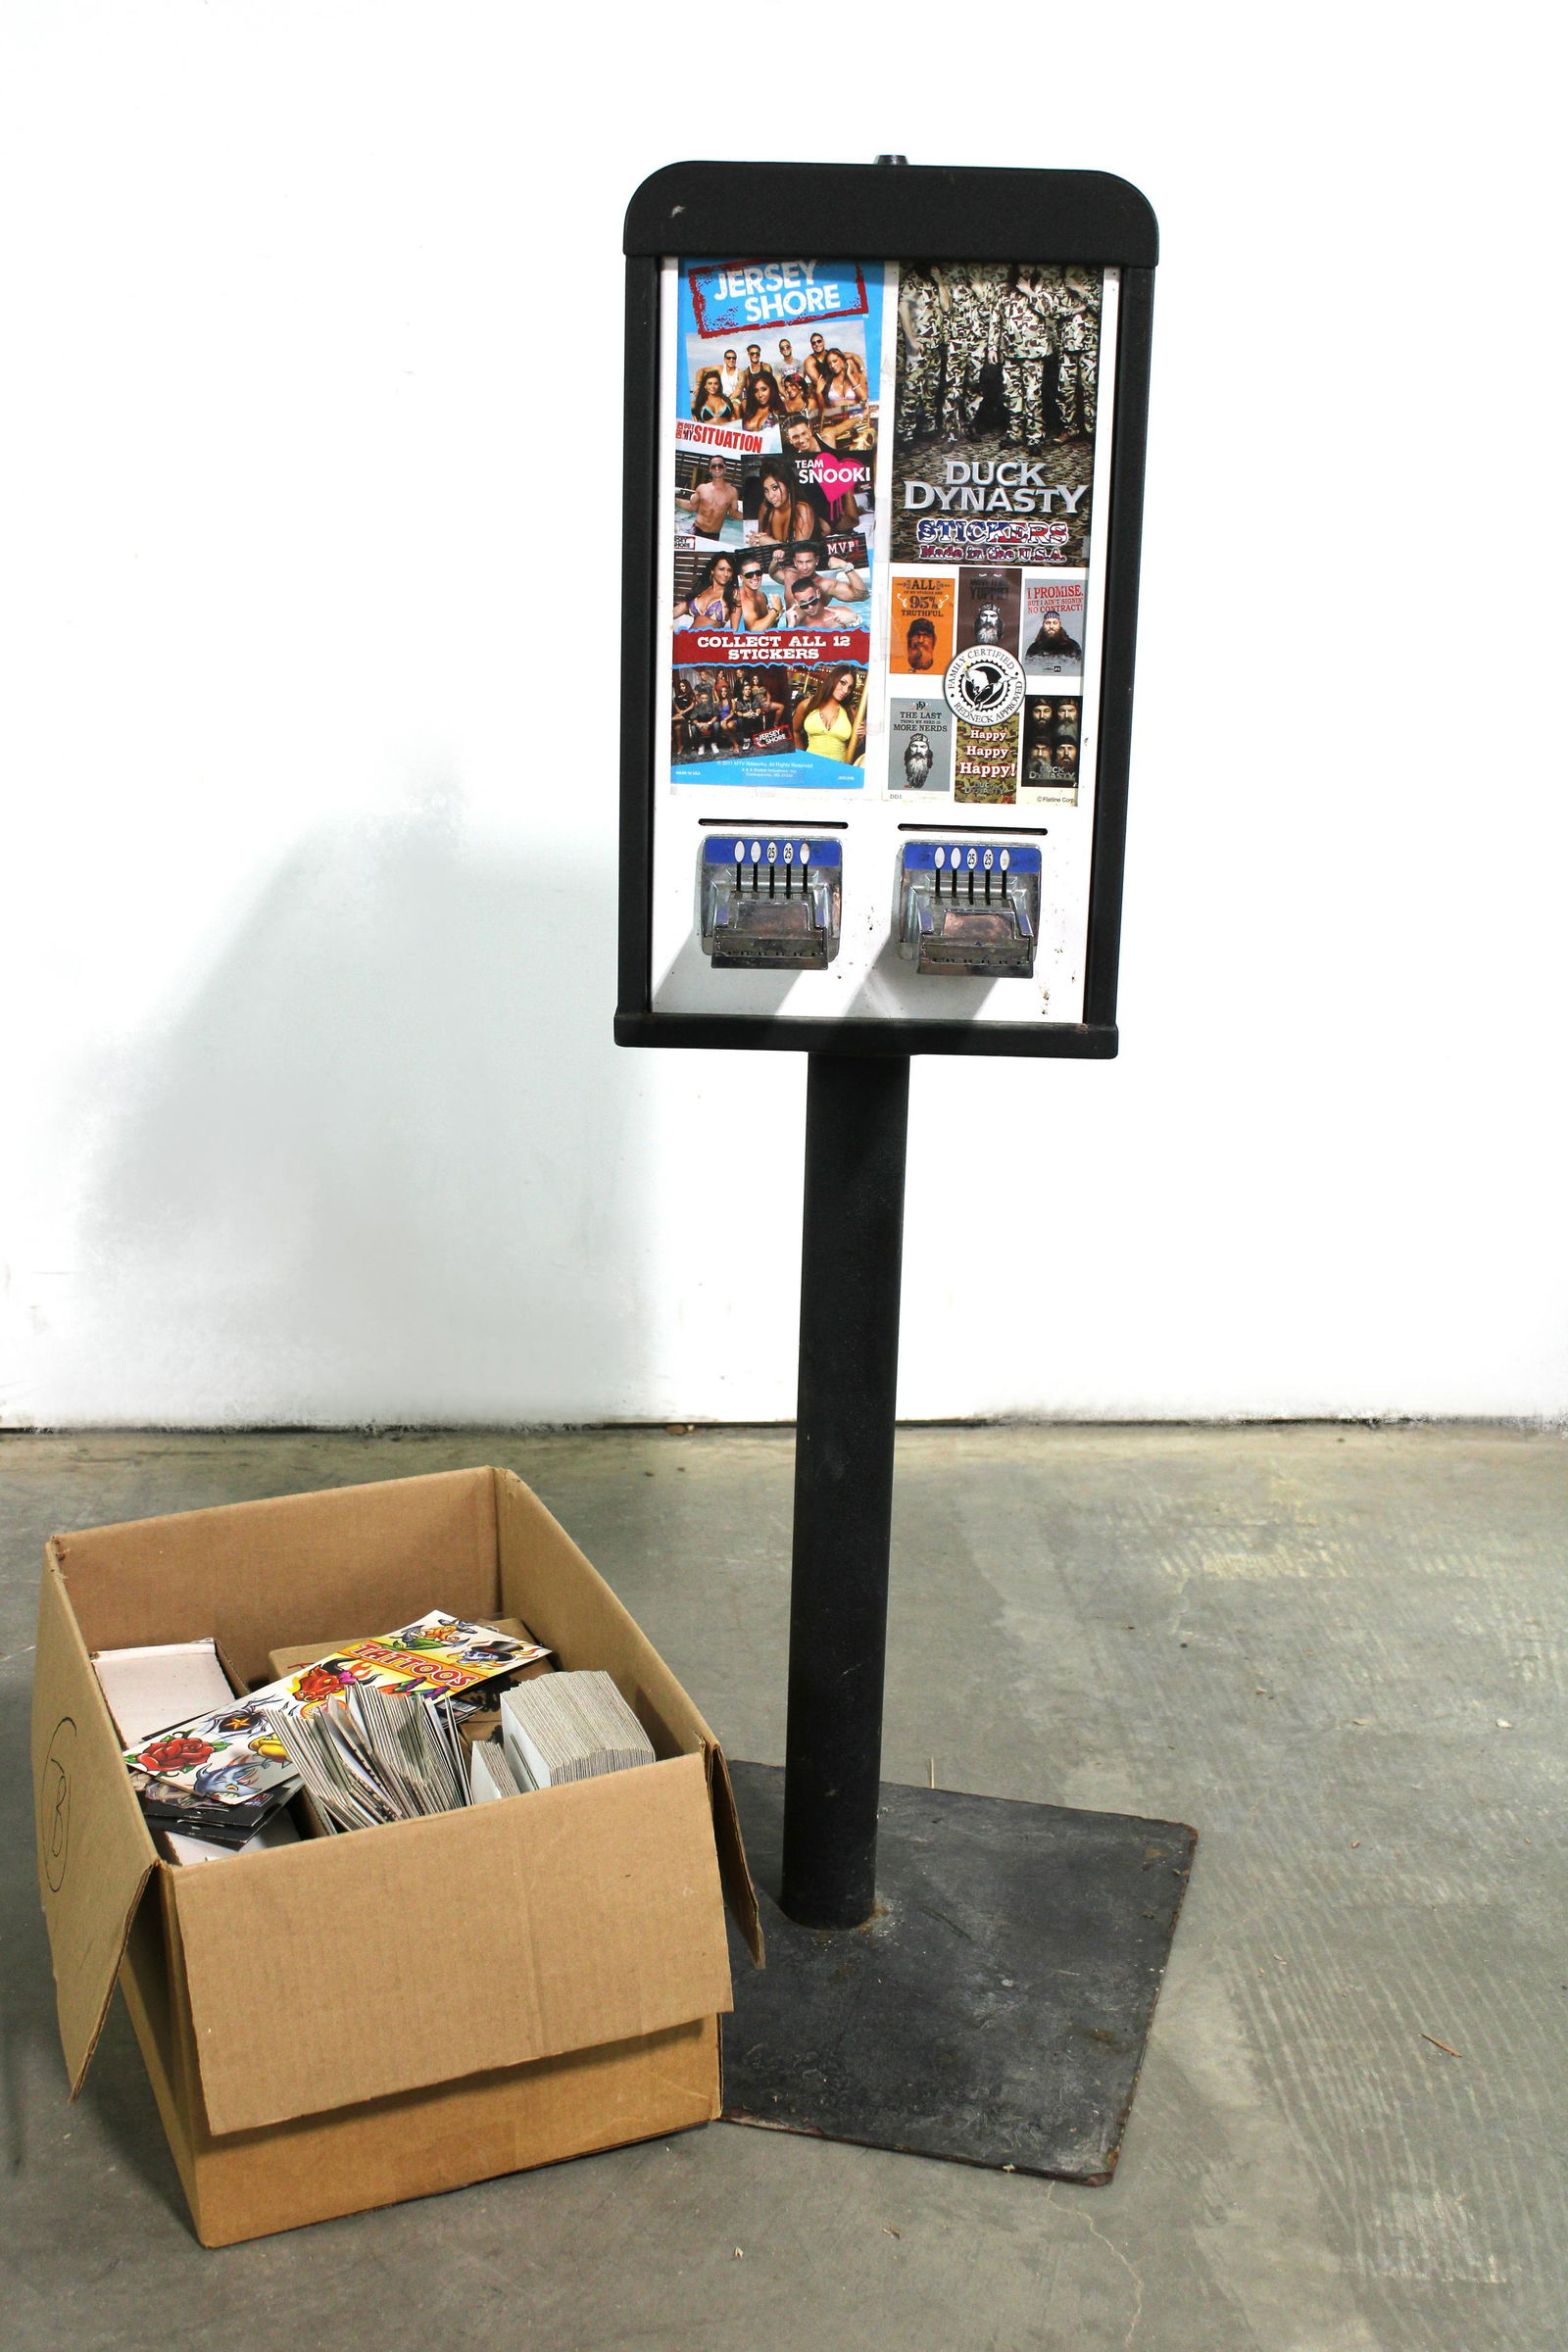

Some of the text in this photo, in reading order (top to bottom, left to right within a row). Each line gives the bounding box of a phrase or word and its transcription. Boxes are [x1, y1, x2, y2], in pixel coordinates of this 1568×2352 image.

[713, 259, 816, 300] JERSEY
[745, 284, 841, 321] SHORE
[693, 424, 762, 453] SITUATION
[795, 460, 824, 469] TEAM
[799, 466, 870, 484] SNOOKI
[945, 461, 1048, 487] DUCK
[903, 480, 1089, 514] DYNASTY
[916, 518, 1068, 544] STICKERS
[919, 545, 1066, 562] Made in the U.S.A.
[911, 580, 936, 590] ALL
[1027, 588, 1031, 599] I
[909, 596, 938, 609] 95%
[697, 636, 851, 649] COLLECT ALL 12
[728, 649, 819, 661] STICKERS
[949, 648, 1014, 689] FAMILY CERTIFIED
[954, 680, 1022, 723] REDNECK APPROVED
[970, 729, 1006, 742] Happy
[966, 746, 1009, 760] Happy
[959, 762, 1016, 778] Happy!
[768, 848, 775, 858] 25
[785, 848, 792, 858] 25
[968, 854, 975, 865] 25
[984, 854, 992, 865] 25
[351, 1642, 479, 1688] TATTOOS
